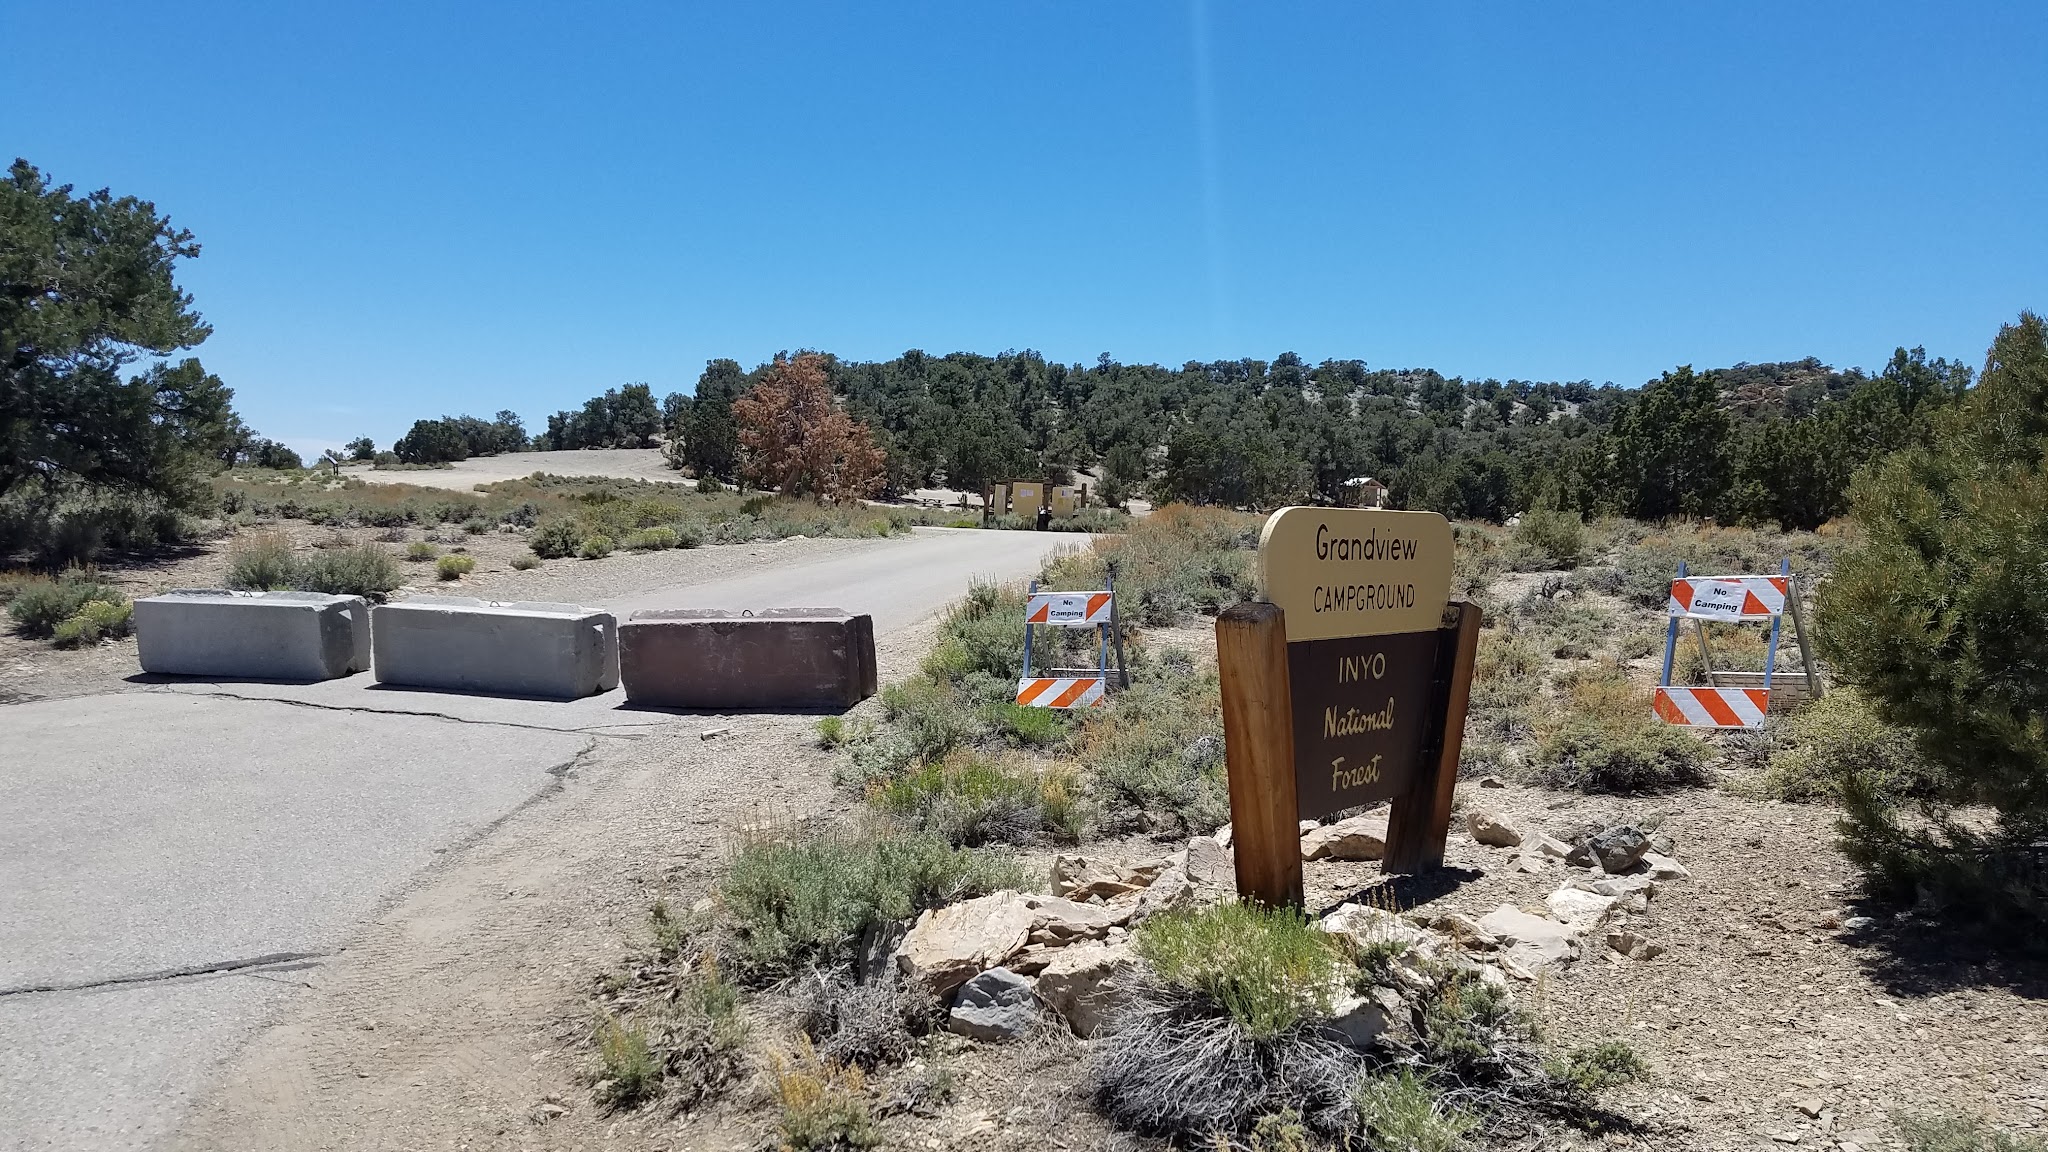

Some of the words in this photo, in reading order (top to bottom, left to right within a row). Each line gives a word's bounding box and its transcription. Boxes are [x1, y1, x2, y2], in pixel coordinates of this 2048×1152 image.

[1316, 523, 1418, 562] Grandview
[1313, 583, 1416, 613] CAMPGROUND
[1695, 599, 1738, 612] Camping
[1713, 587, 1727, 596] No
[1339, 652, 1386, 684] INYO
[1323, 696, 1396, 740] National
[1331, 753, 1384, 793] Forest
